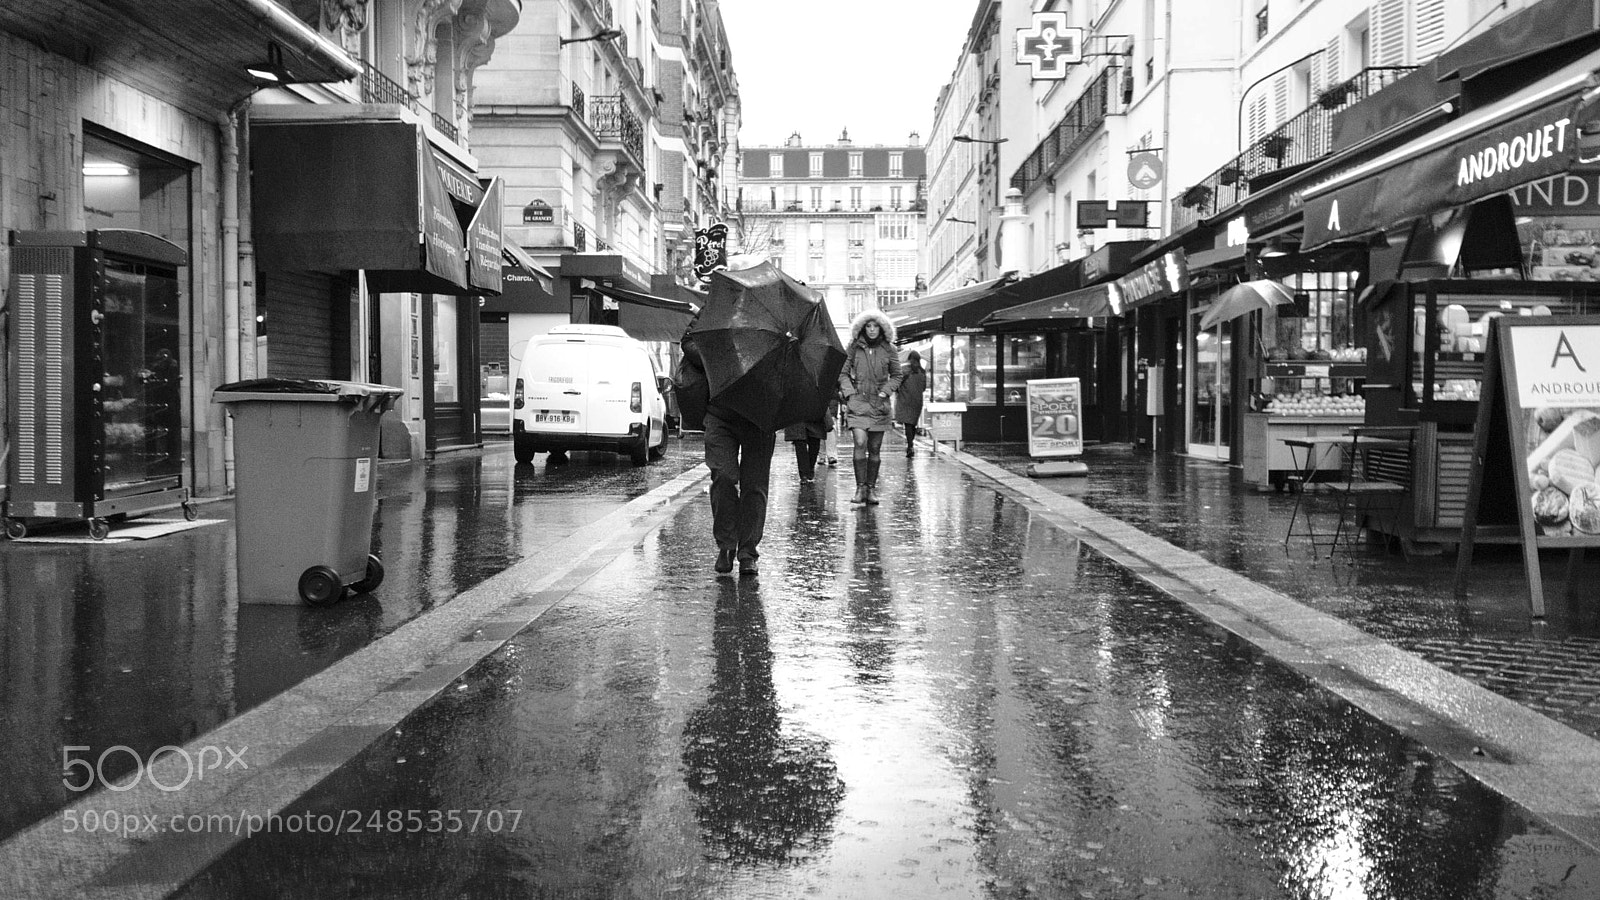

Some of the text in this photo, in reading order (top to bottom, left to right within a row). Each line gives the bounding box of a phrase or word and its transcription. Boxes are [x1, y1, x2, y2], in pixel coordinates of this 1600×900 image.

[1457, 118, 1571, 187] ANDROUET
[1327, 199, 1341, 231] A
[1551, 330, 1587, 373] A
